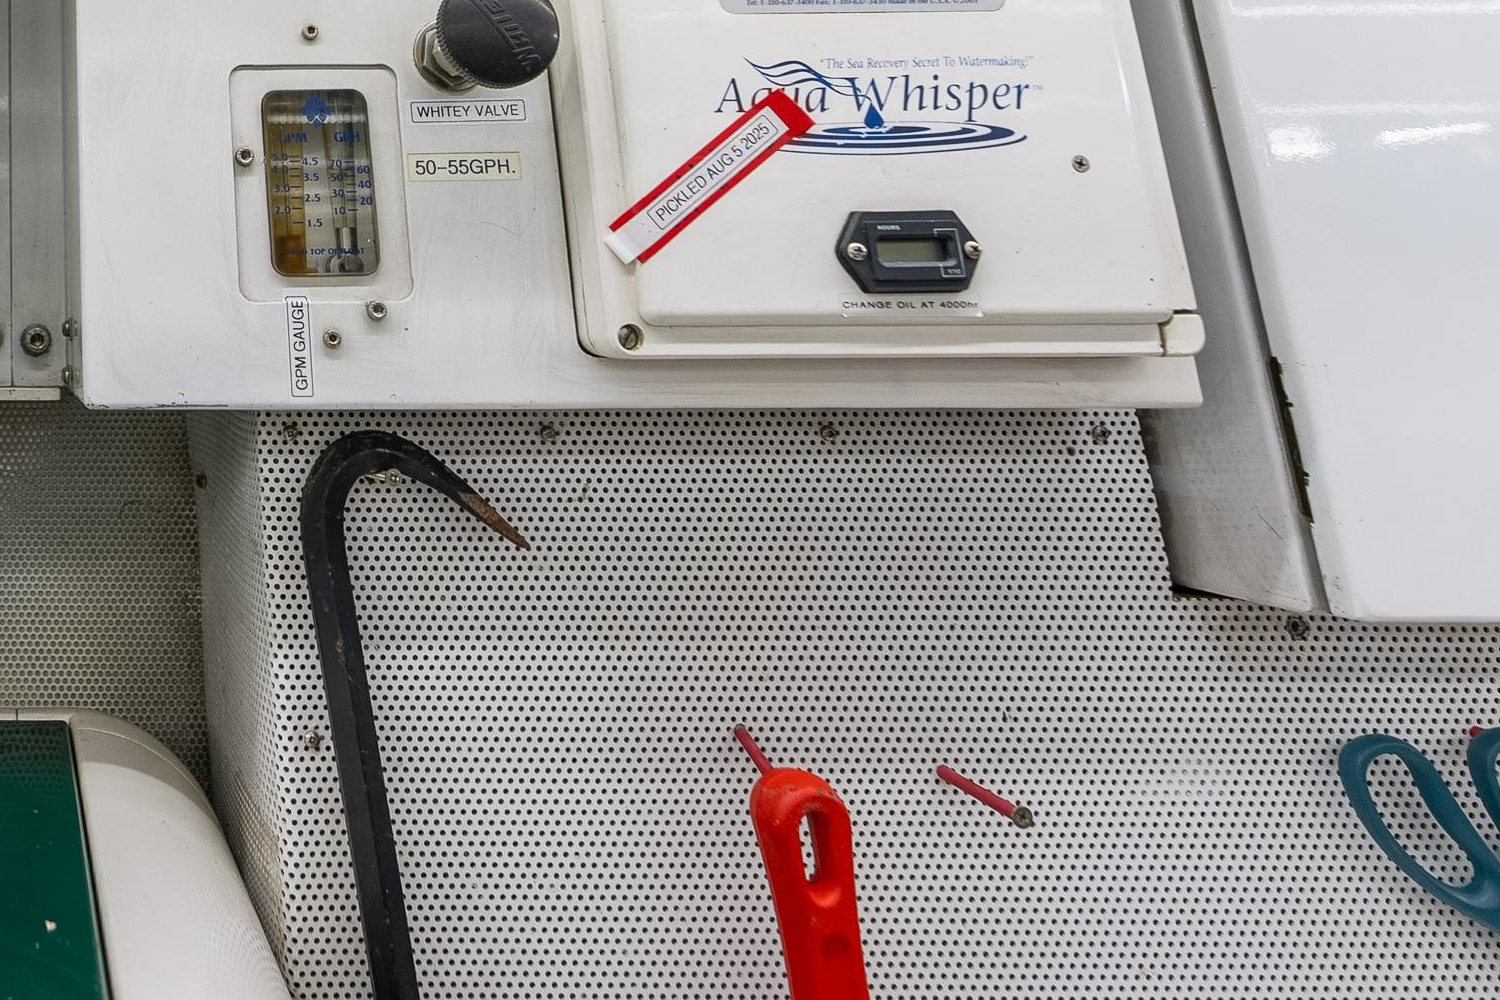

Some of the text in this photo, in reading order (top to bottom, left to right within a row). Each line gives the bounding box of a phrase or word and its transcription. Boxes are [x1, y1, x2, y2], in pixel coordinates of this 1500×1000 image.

[847, 58, 864, 69] Sea
[867, 57, 909, 70] Recovery
[913, 56, 940, 68] Secret
[942, 56, 955, 67] To
[850, 74, 1030, 122] Whisper
[416, 104, 519, 119] WHITEY VALVE
[302, 158, 319, 166] 4.5
[330, 159, 342, 168] 70
[357, 166, 370, 174] 60
[655, 122, 770, 222] PICKLED AUG 5 2025
[303, 173, 320, 182] 3.5
[330, 173, 344, 182] 50
[275, 184, 290, 193] 3.0
[358, 180, 372, 189] 40
[332, 189, 344, 198] 30
[304, 194, 321, 203] 2.5
[360, 196, 372, 206] 20
[276, 206, 291, 214] 2.0
[334, 206, 346, 215] 10
[308, 219, 323, 228] 1.5
[842, 300, 979, 310] CHANGE OIL AT 4000hr
[291, 300, 308, 390] GPM GAUGE
